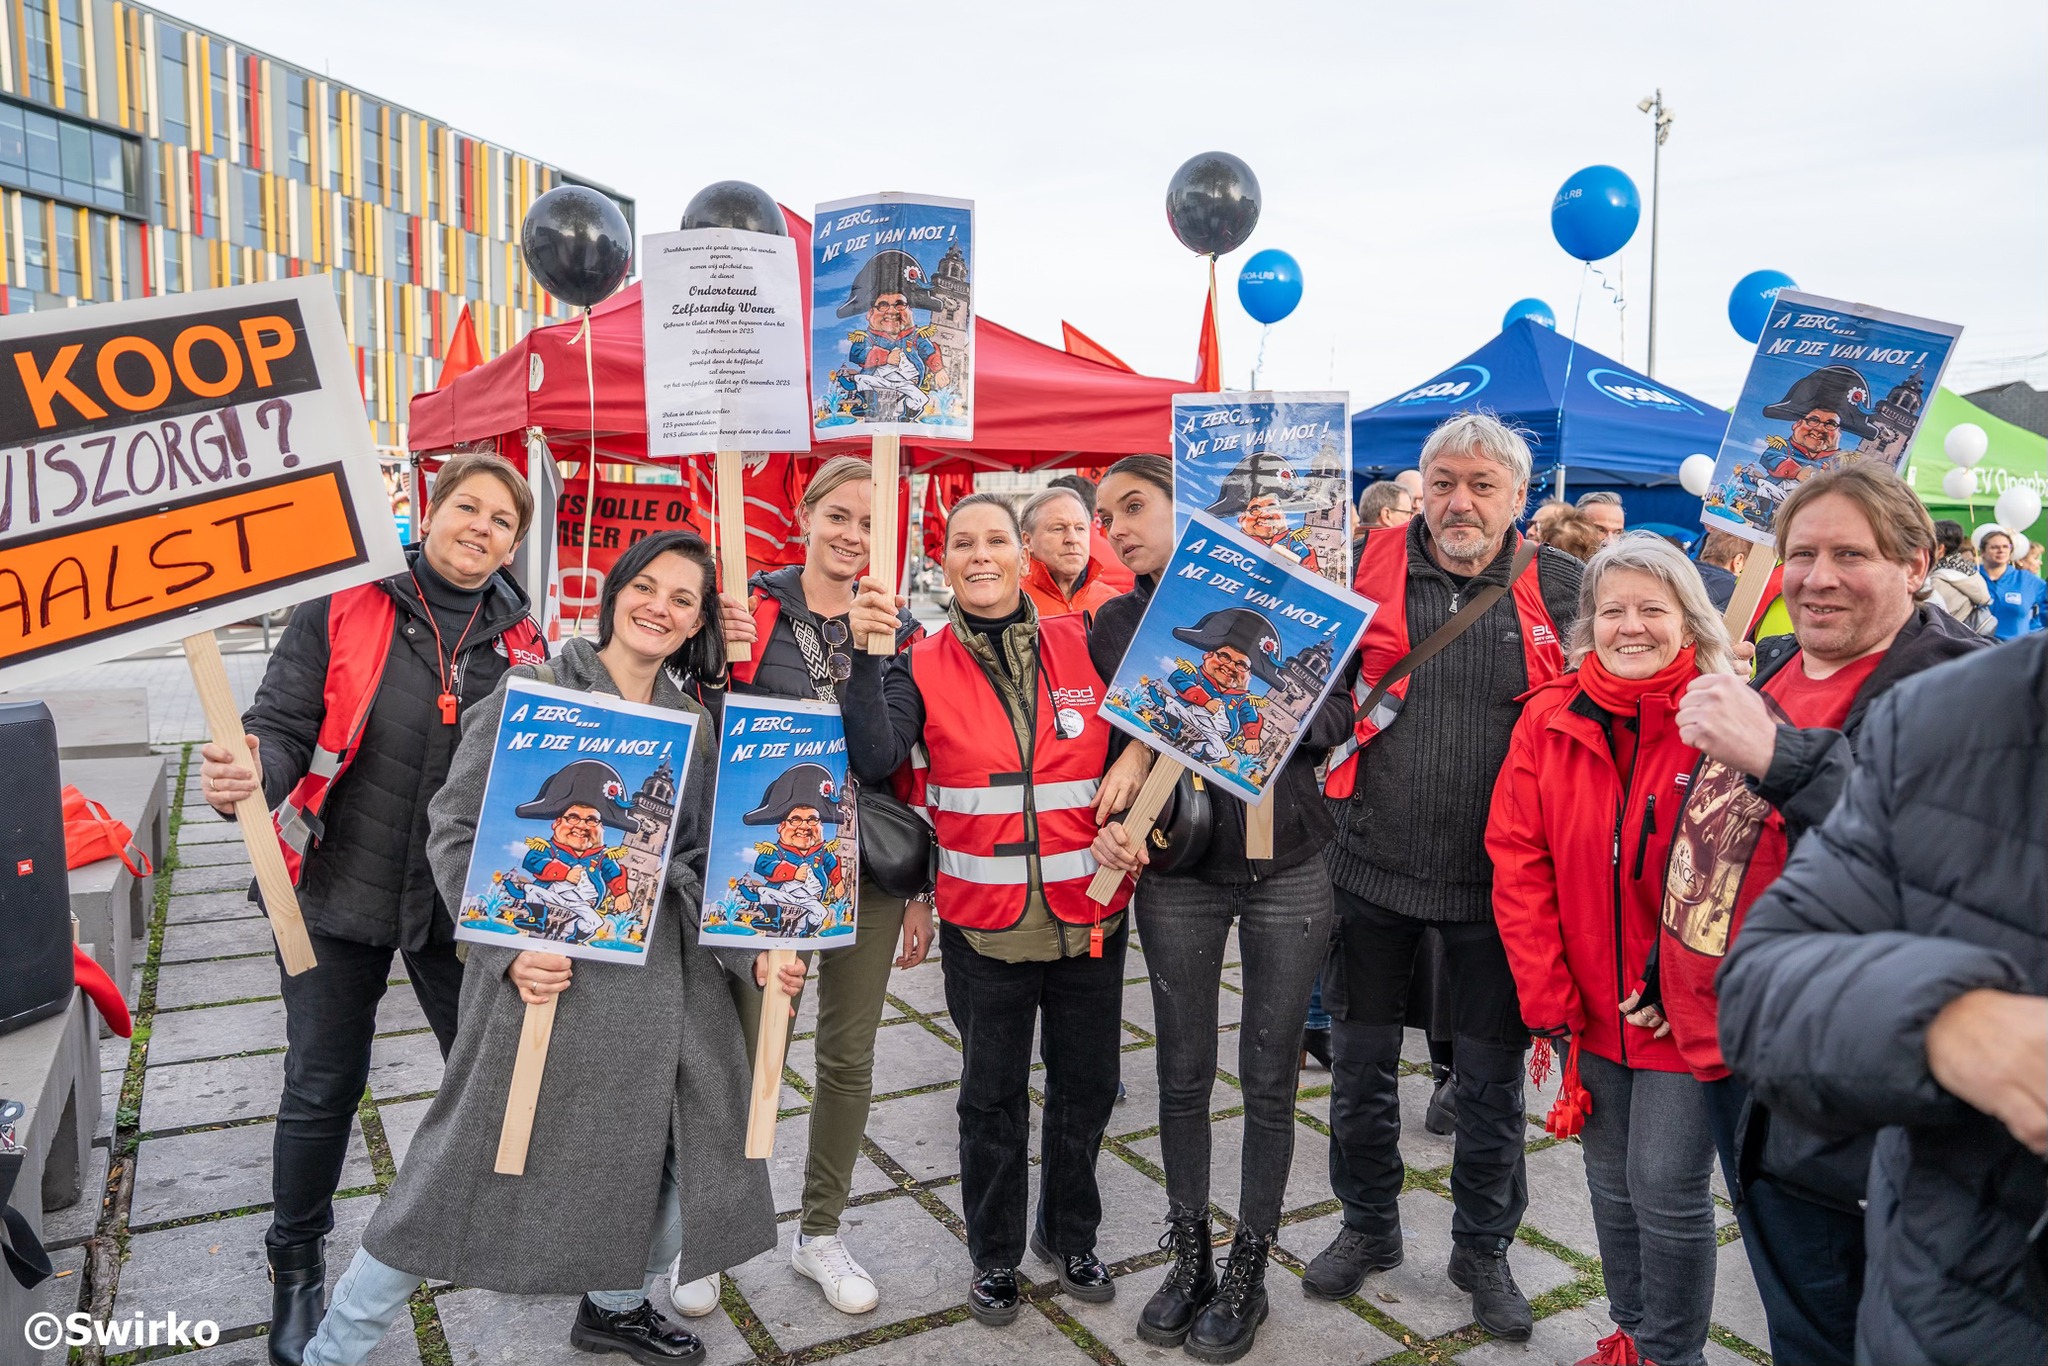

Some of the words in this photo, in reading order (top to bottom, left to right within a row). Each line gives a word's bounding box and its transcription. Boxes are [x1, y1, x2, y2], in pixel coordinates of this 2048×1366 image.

[819, 221, 832, 239] A
[836, 209, 890, 231] ZERG....
[822, 241, 842, 264] NI
[845, 234, 870, 254] DIE
[874, 228, 906, 246] VAN
[908, 225, 945, 242] MOI
[947, 225, 956, 242] !
[689, 285, 757, 296] Ondersteund
[672, 302, 736, 316] Zelfstandig
[738, 303, 775, 314] Wonen
[1773, 312, 1792, 328] A
[1794, 314, 1856, 336] ZERG....
[1767, 338, 1796, 355] NI
[1794, 340, 1828, 356] DIE
[1829, 344, 1868, 360] VAN
[1866, 347, 1914, 365] MOI
[1911, 352, 1928, 369] !
[13, 315, 297, 430] KOOP
[1181, 416, 1195, 435] A
[1201, 409, 1260, 429] ZERG....
[1185, 439, 1209, 460] NI
[1212, 434, 1241, 453] DIE
[1246, 429, 1276, 448] VAN
[1279, 423, 1319, 441] MOI
[1320, 421, 1330, 440] !
[1185, 538, 1208, 554] A
[1208, 545, 1272, 585] ZERG....
[1178, 562, 1210, 581] NI
[1208, 573, 1244, 595] DIE
[1244, 587, 1283, 610] VAN
[1280, 604, 1328, 629] MOI
[1323, 622, 1342, 636] !
[509, 704, 529, 722] A
[532, 705, 601, 728] ZERG....
[729, 718, 746, 736] A
[750, 716, 812, 734] ZERG....
[507, 731, 539, 750] NI
[539, 733, 575, 750] DIE
[577, 737, 616, 753] VAN
[615, 739, 660, 756] MOI
[659, 741, 673, 759] !
[730, 744, 757, 763] NI
[759, 743, 790, 758] DIE
[794, 741, 826, 756] VAN
